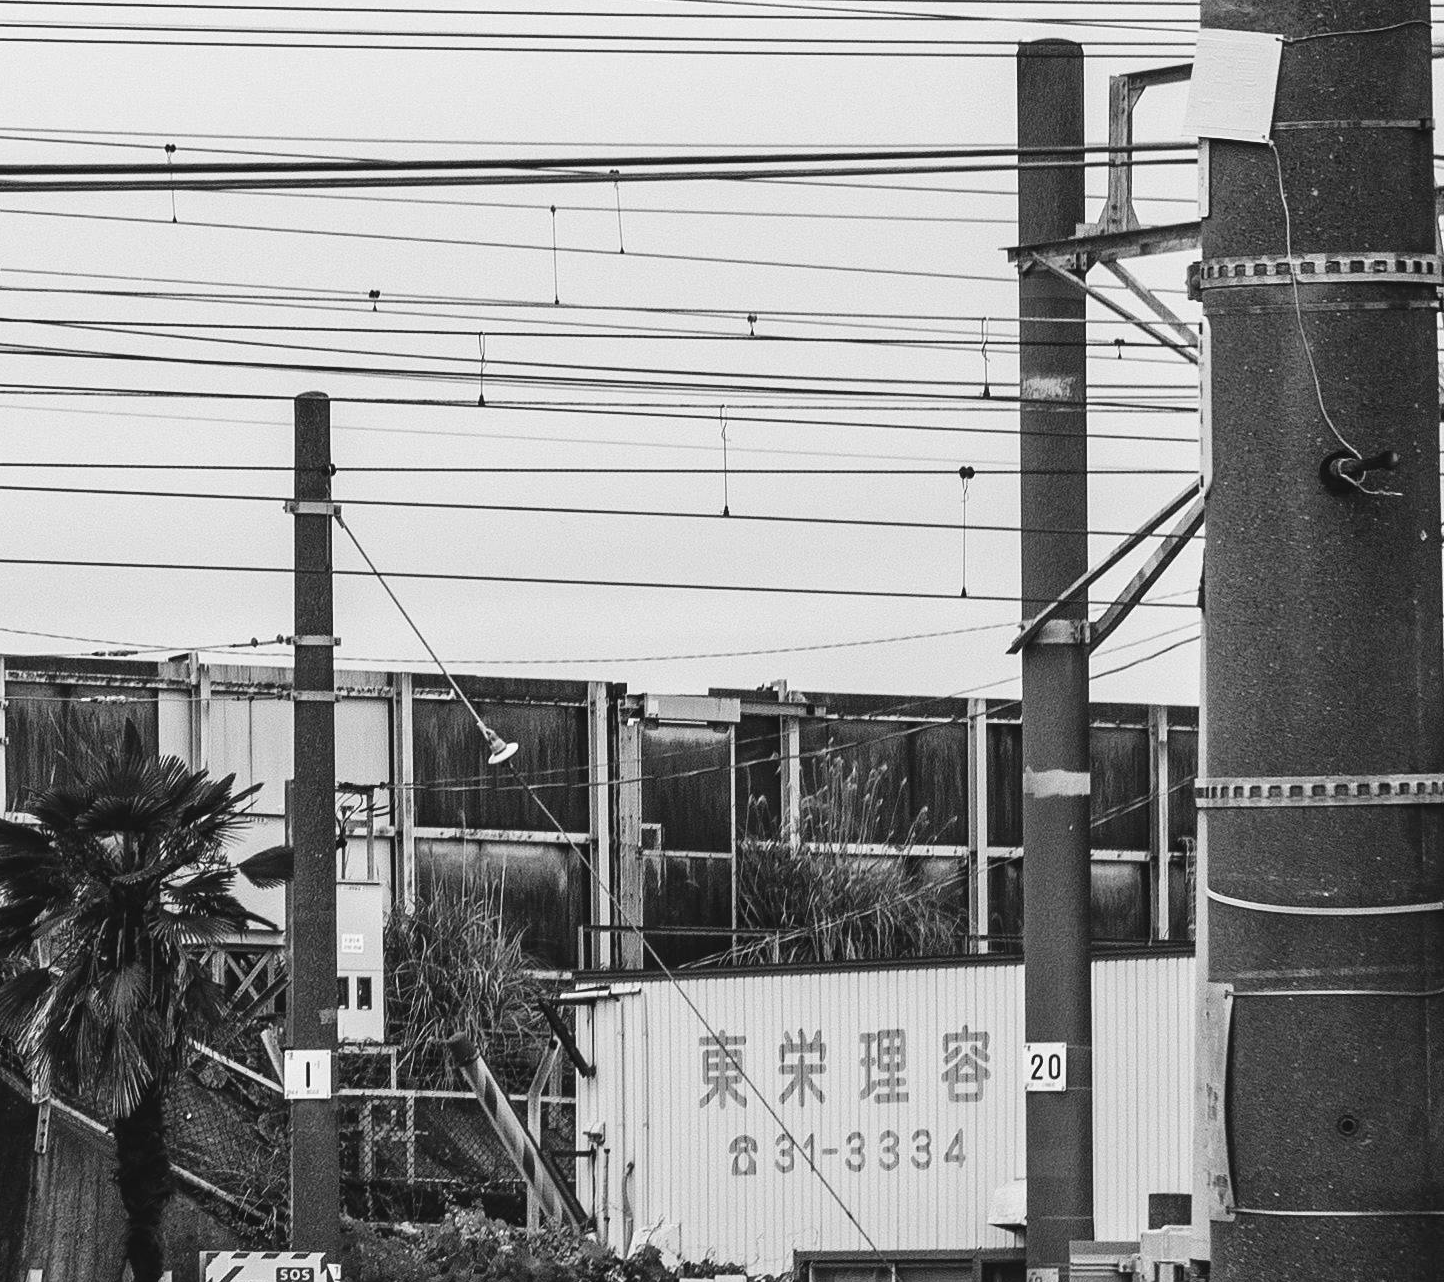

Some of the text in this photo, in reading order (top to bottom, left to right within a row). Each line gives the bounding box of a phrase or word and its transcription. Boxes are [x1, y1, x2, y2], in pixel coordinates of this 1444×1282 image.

[698, 1024, 991, 1110] 東栄理容
[1030, 1053, 1061, 1080] 20
[280, 1269, 310, 1280] SOS
